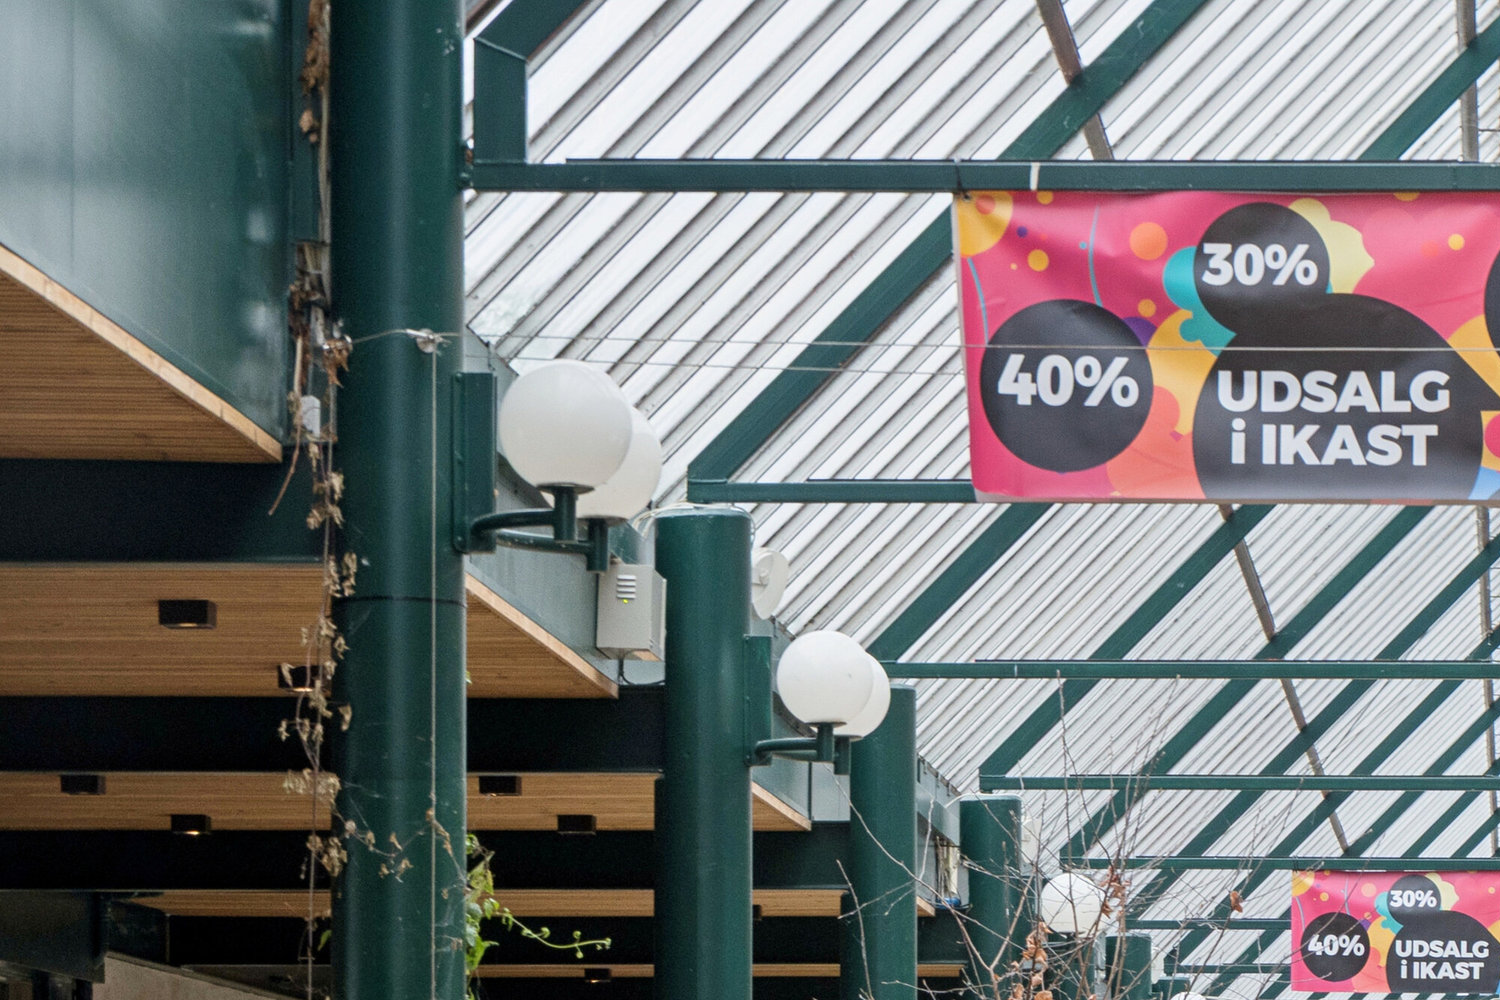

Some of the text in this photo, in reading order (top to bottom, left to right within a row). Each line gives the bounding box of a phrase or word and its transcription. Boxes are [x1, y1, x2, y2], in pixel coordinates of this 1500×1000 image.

[1202, 243, 1318, 286] 30%
[998, 353, 1139, 408] 40%
[1217, 369, 1451, 414] UDSALG
[1230, 417, 1439, 467] i IKAST
[1390, 889, 1437, 908] 30%
[1308, 934, 1365, 956] 40%
[1395, 940, 1489, 958] UDSALG
[1401, 959, 1484, 979] i IKAST
